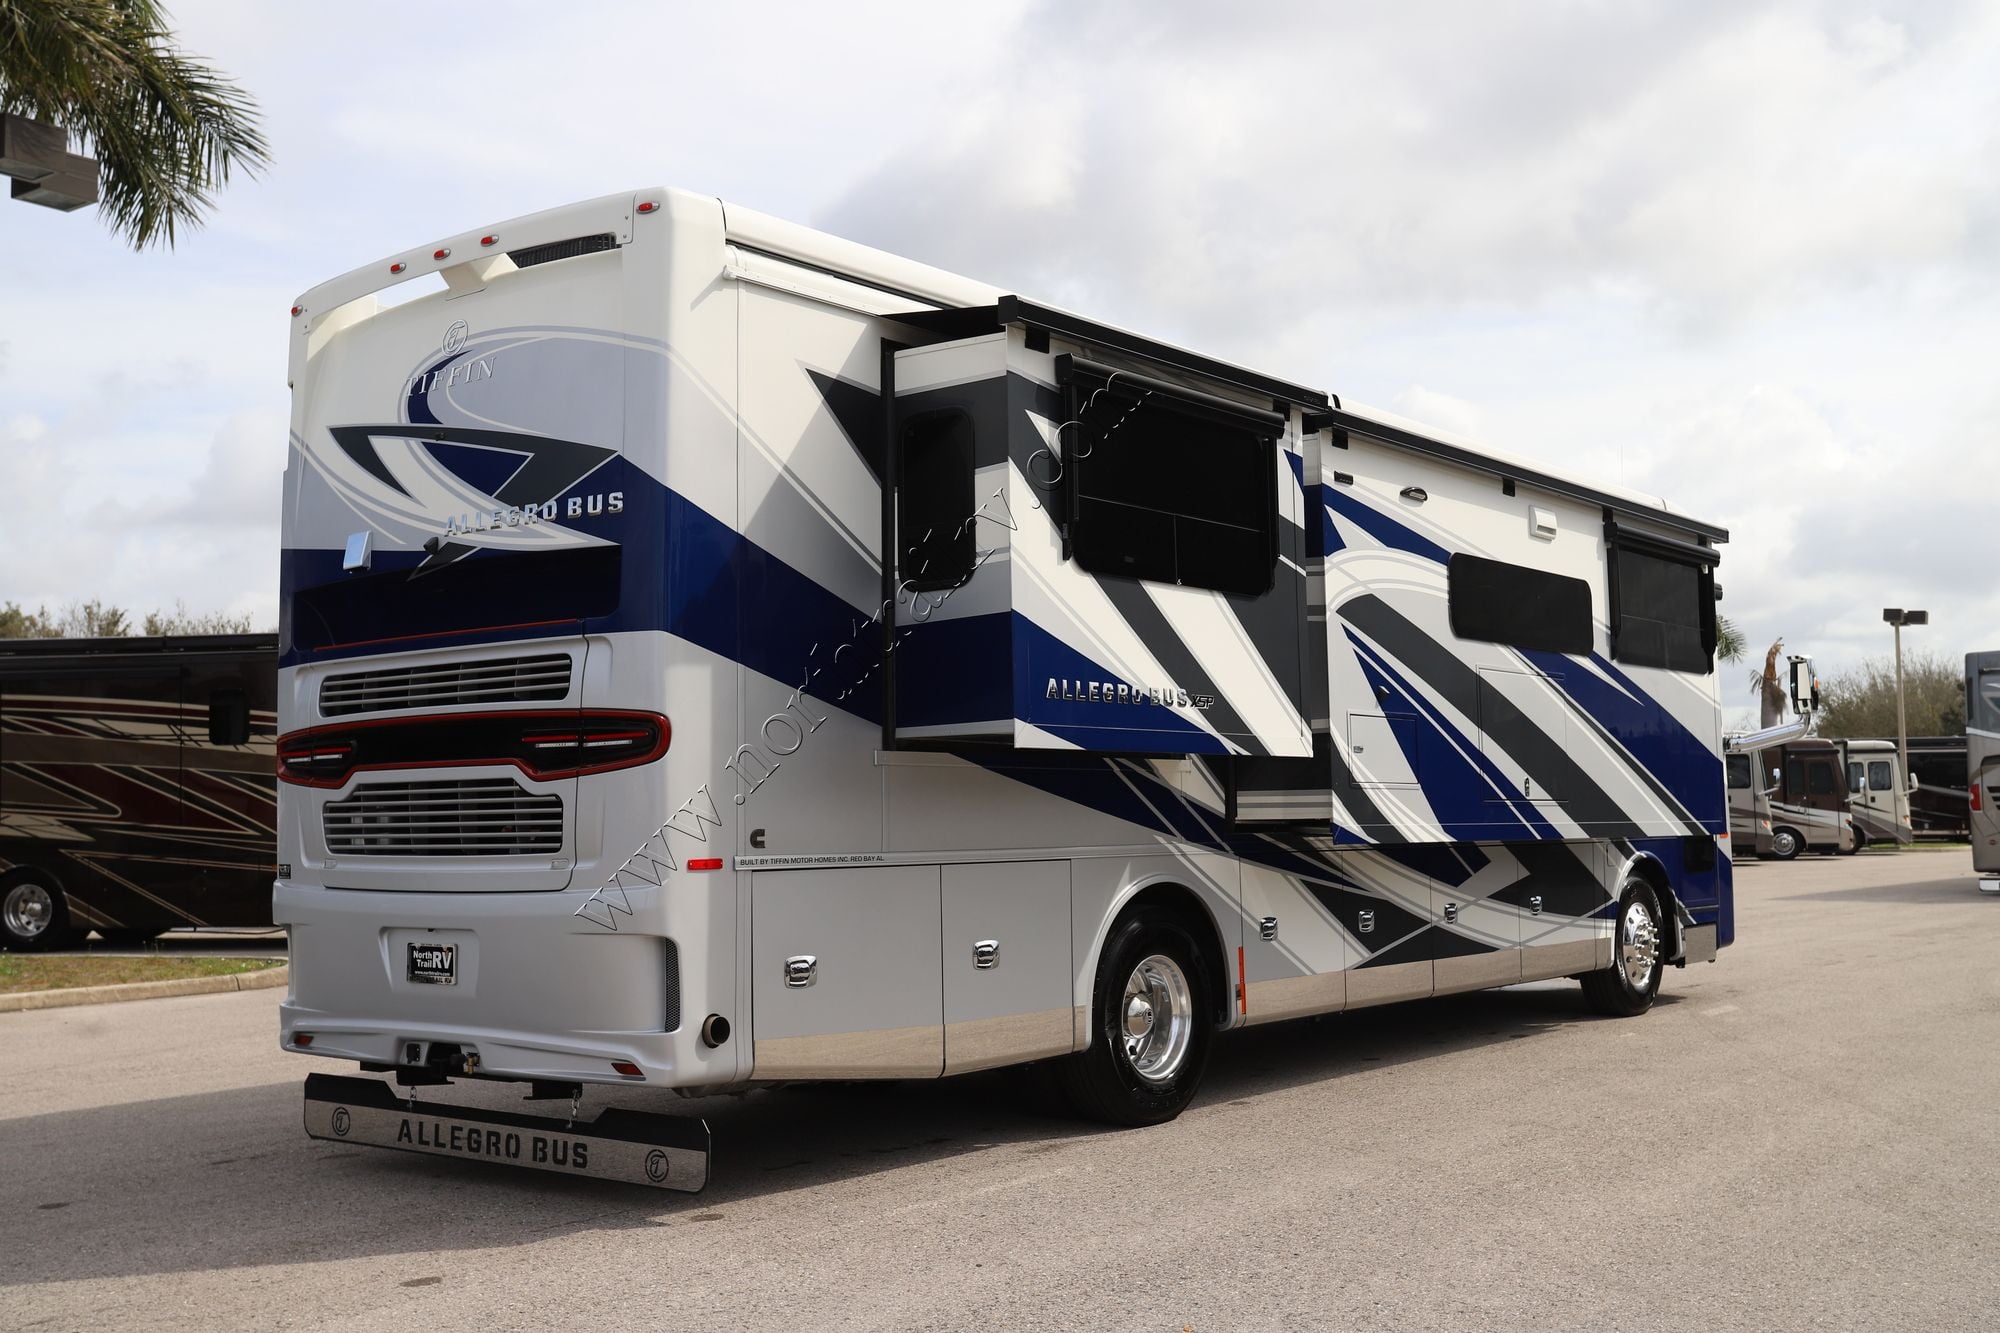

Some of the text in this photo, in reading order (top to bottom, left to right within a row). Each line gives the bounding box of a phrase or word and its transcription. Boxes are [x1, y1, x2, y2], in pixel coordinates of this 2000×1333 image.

[403, 356, 497, 397] TIFFIN
[444, 491, 624, 538] ALLEGRO BUS
[1046, 677, 1144, 705] ALLEGRO
[1149, 687, 1188, 709] BUS
[770, 857, 789, 865] TIFFIN
[413, 950, 452, 969] North RV
[416, 959, 432, 968] Trail
[398, 1119, 589, 1169] ALLEGRO BUS
